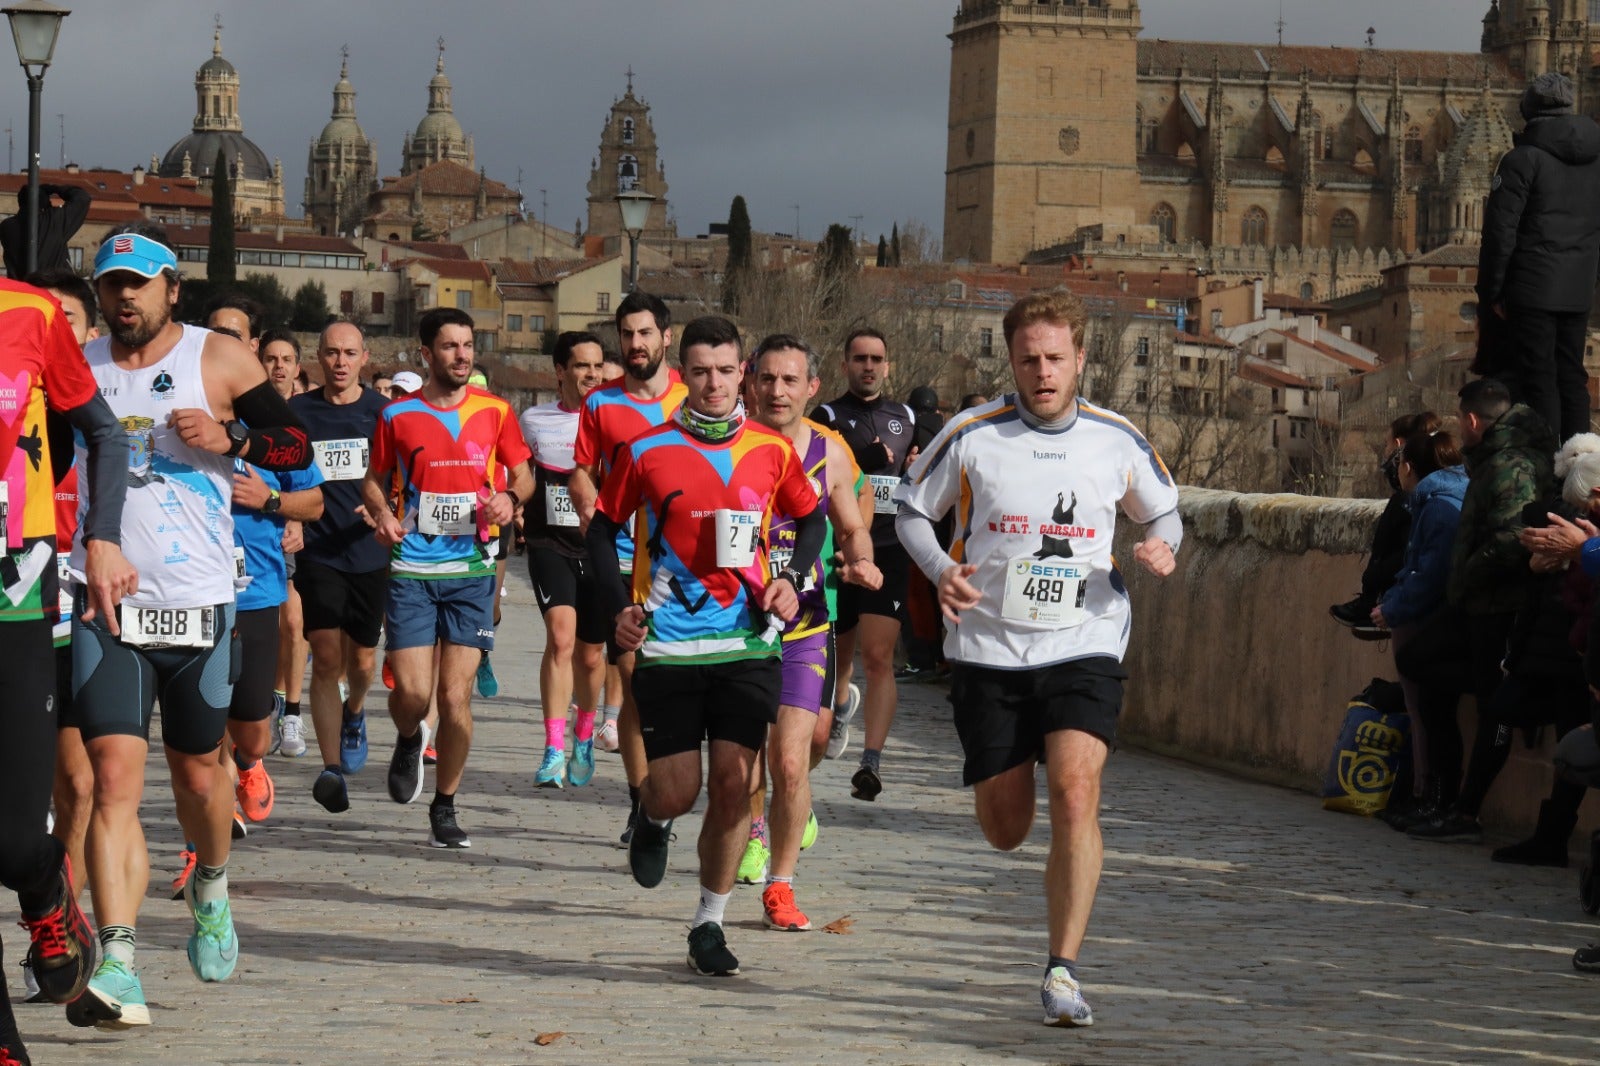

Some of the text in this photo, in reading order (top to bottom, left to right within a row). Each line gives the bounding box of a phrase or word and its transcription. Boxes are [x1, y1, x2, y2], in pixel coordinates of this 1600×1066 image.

[327, 441, 362, 449] SETEL
[325, 450, 351, 467] 373
[1033, 450, 1066, 460] luanvi
[436, 495, 471, 504] SETEL
[872, 485, 890, 501] 48
[431, 504, 460, 521] 466
[1040, 524, 1085, 538] GARSAN
[1031, 565, 1081, 578] SETEL
[1022, 577, 1064, 603] 489
[138, 609, 188, 636] 1398
